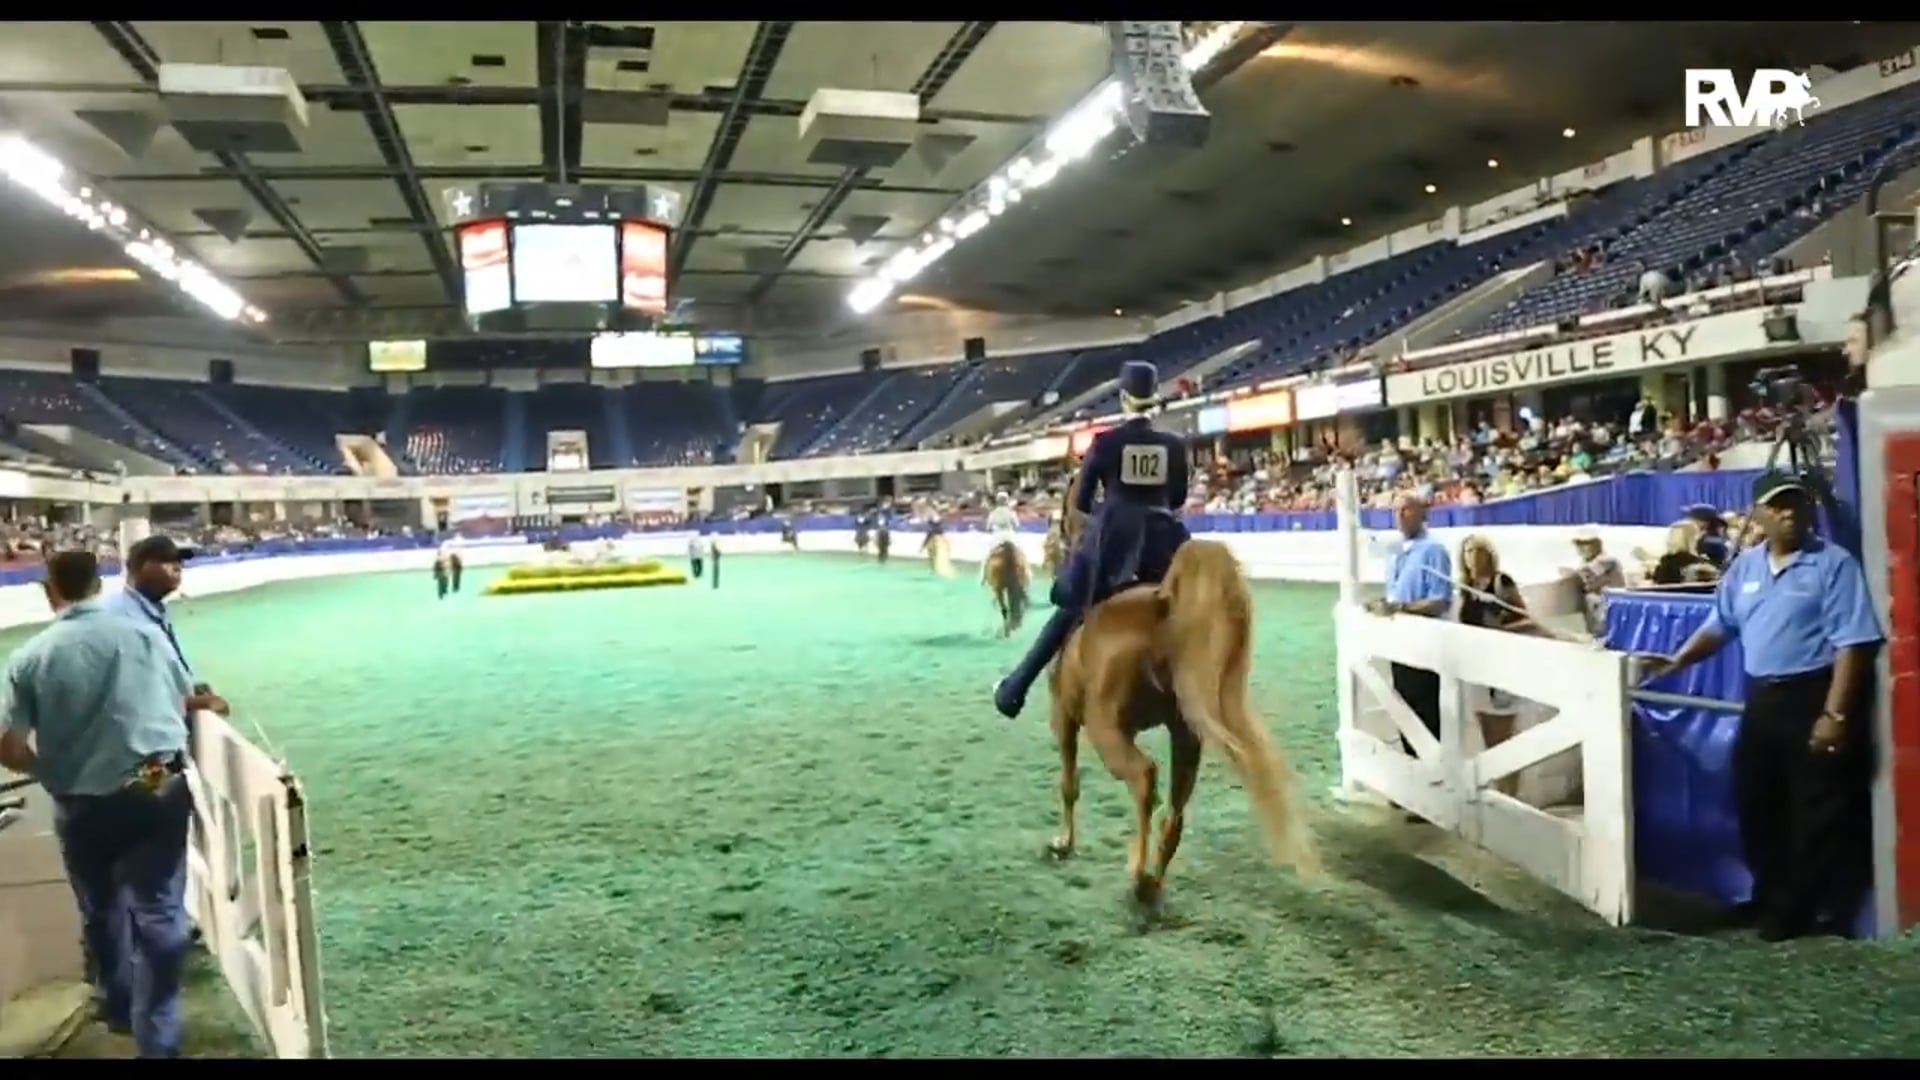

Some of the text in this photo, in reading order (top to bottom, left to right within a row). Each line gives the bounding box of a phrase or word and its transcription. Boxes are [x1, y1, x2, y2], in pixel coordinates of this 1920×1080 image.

[1422, 325, 1697, 396] LOUISVILLE KY
[1131, 453, 1160, 477] 102
